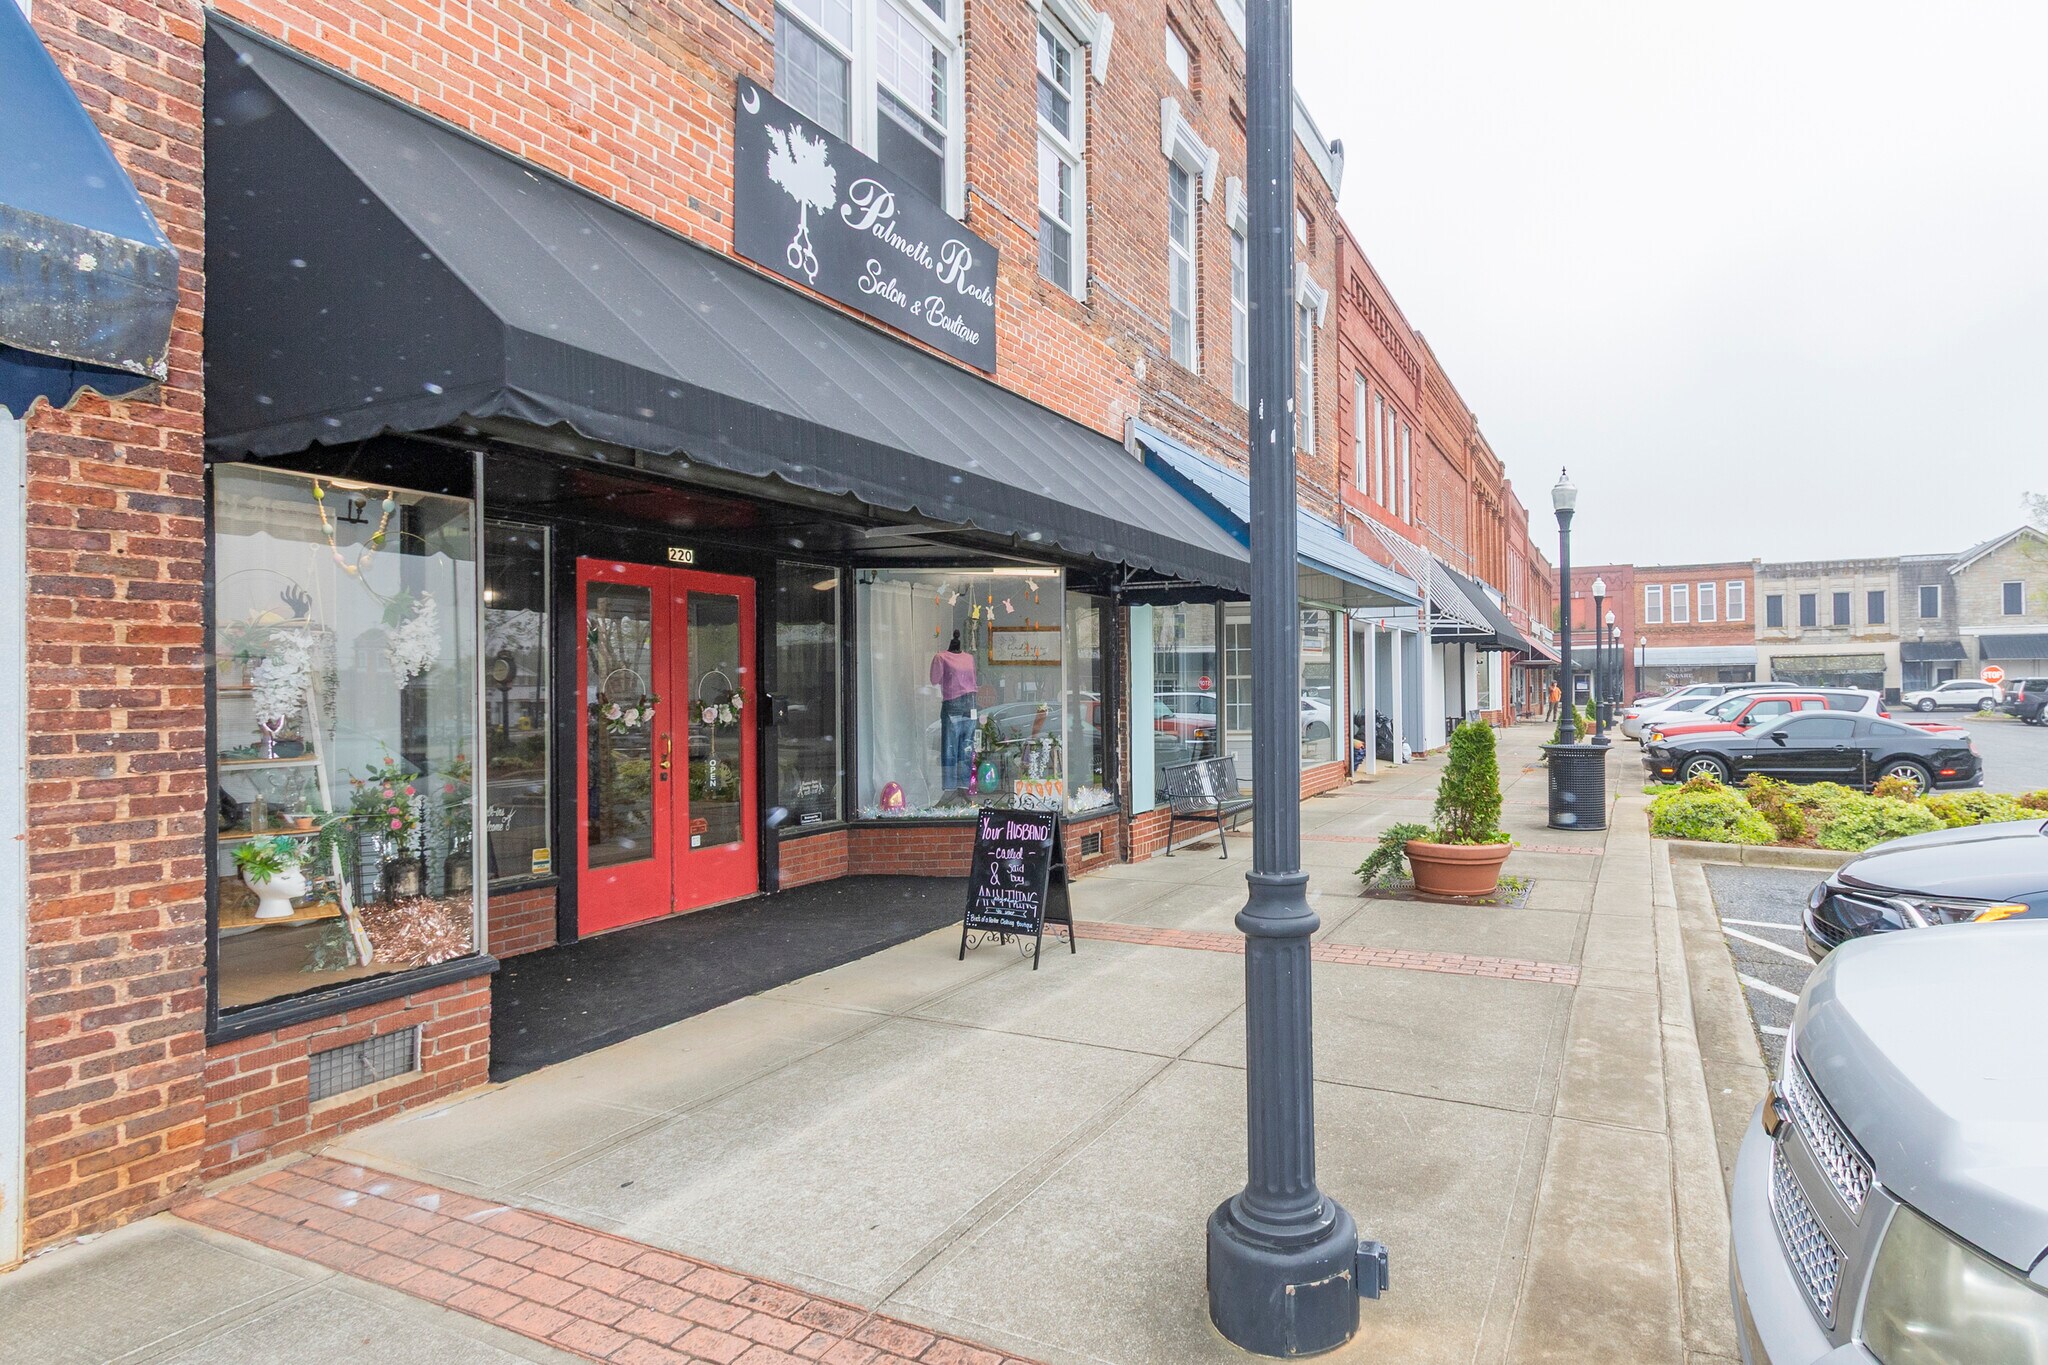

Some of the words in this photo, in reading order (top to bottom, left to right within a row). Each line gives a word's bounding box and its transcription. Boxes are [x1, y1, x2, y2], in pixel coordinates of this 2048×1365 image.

[840, 178, 934, 270] Palmetto
[936, 238, 995, 307] Roots
[858, 259, 908, 308] Salon
[910, 300, 922, 316] &
[924, 295, 980, 345] Boutique
[670, 548, 692, 562] 220
[1982, 671, 2003, 679] STOP
[709, 759, 717, 787] OPEN
[487, 805, 505, 817] lk-ins
[487, 820, 504, 832] lcome
[982, 816, 1004, 840] Your
[1006, 820, 1049, 841] HUSBAND
[990, 862, 1001, 886] &
[1010, 874, 1025, 887] buy
[976, 885, 1039, 918] ANYTHING
